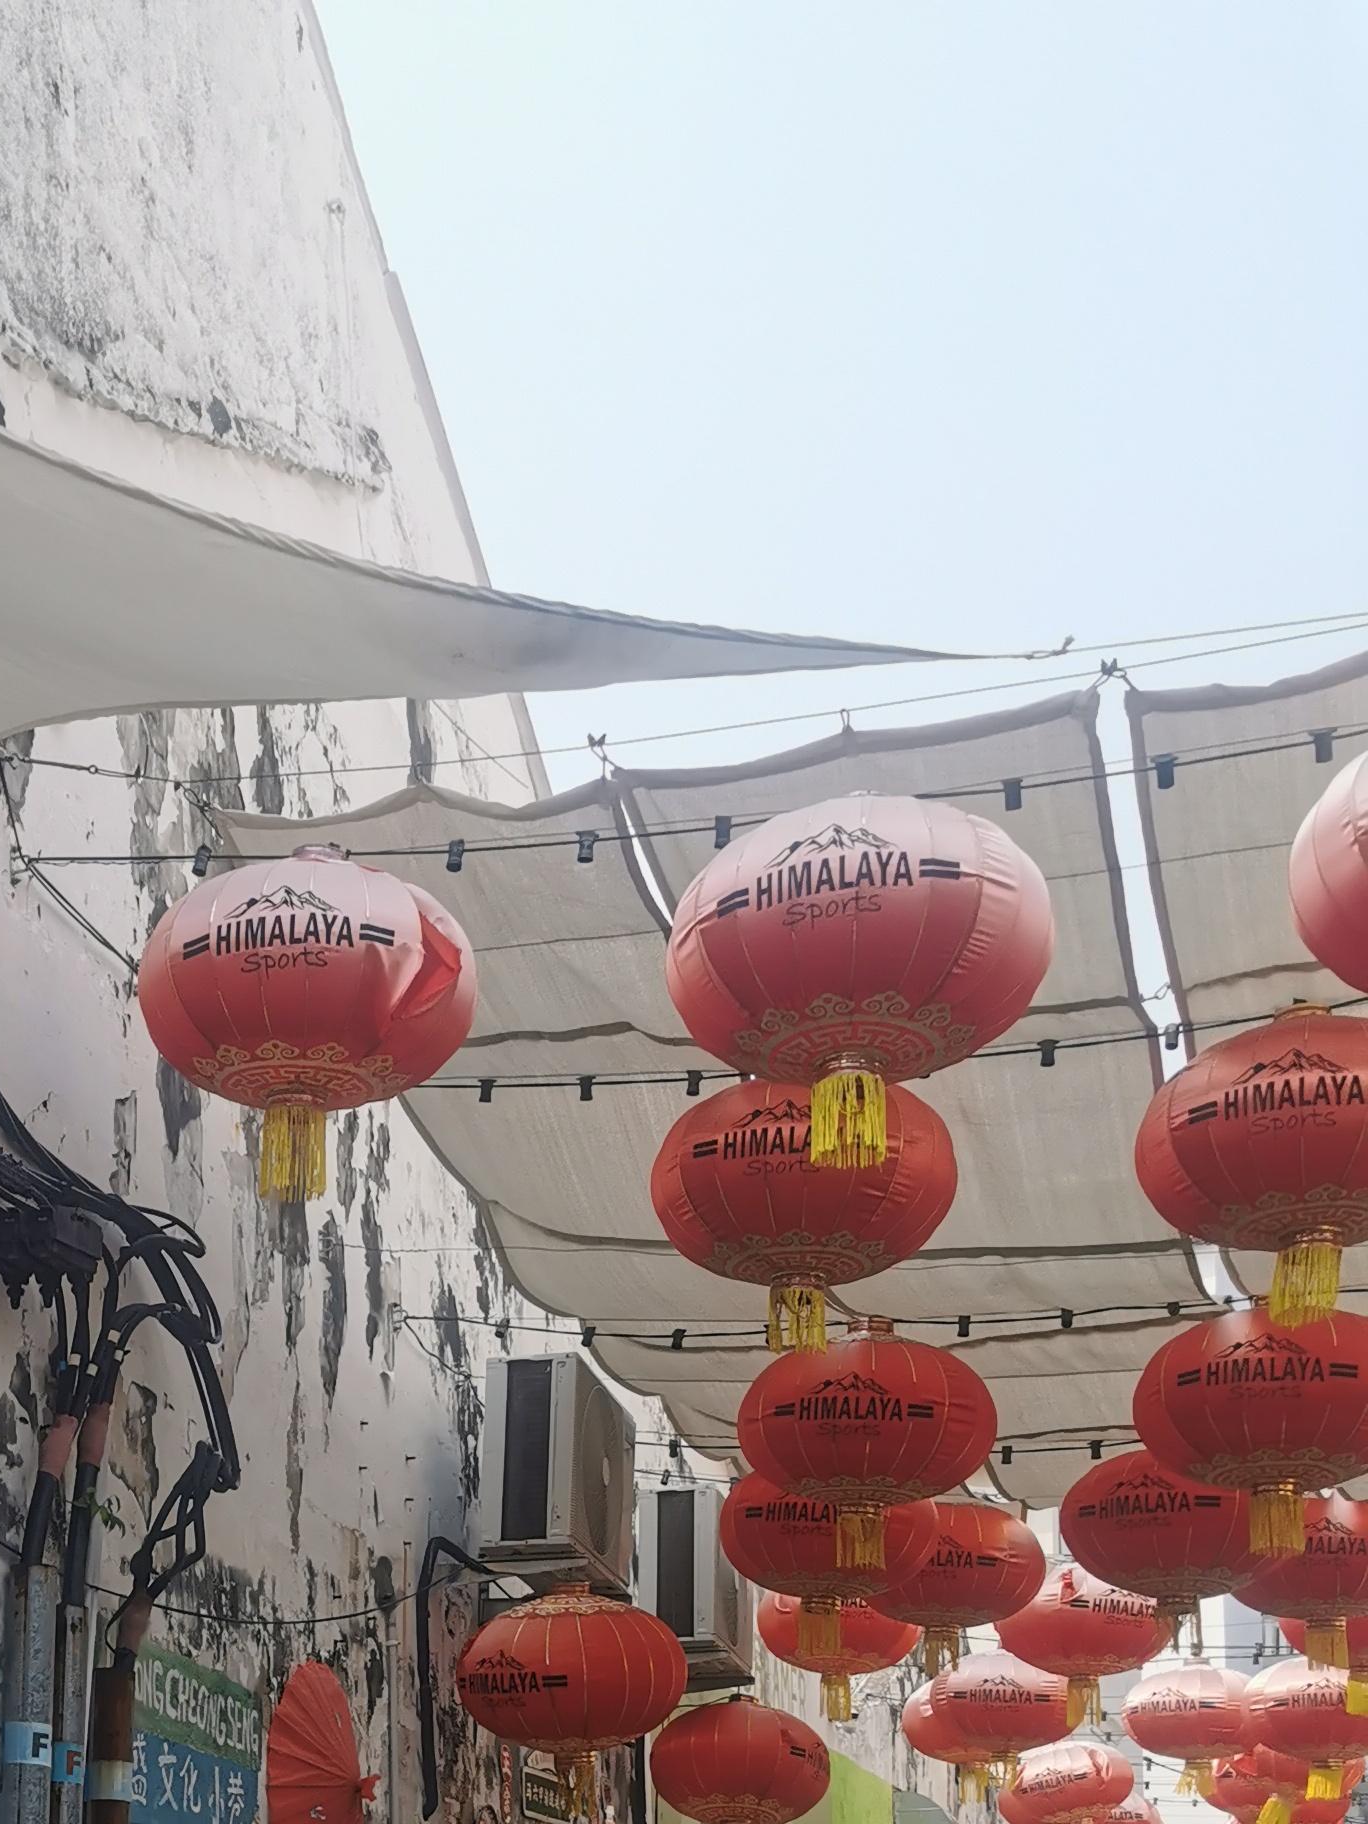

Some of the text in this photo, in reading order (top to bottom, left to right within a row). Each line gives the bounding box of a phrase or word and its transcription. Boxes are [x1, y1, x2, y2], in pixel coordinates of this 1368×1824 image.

[756, 851, 914, 911] HIMALAYA
[782, 889, 882, 929] Sports
[215, 912, 355, 956] HIMALAYA
[240, 945, 329, 980] Sports
[1223, 1074, 1366, 1121] HIMALAYA
[723, 1124, 814, 1160] HIMALA
[1205, 1356, 1325, 1386] HIMALAYA
[798, 1396, 904, 1422] HIMALAYA
[1098, 1491, 1192, 1520] HIMALAYA
[468, 1671, 541, 1695] HIMALAYA
[969, 1688, 1033, 1705] HIMALAYA
[1139, 1699, 1199, 1714] HIMALAYA
[1292, 1691, 1347, 1708] HIMALA
[1028, 1774, 1075, 1794] HIMALAYA
